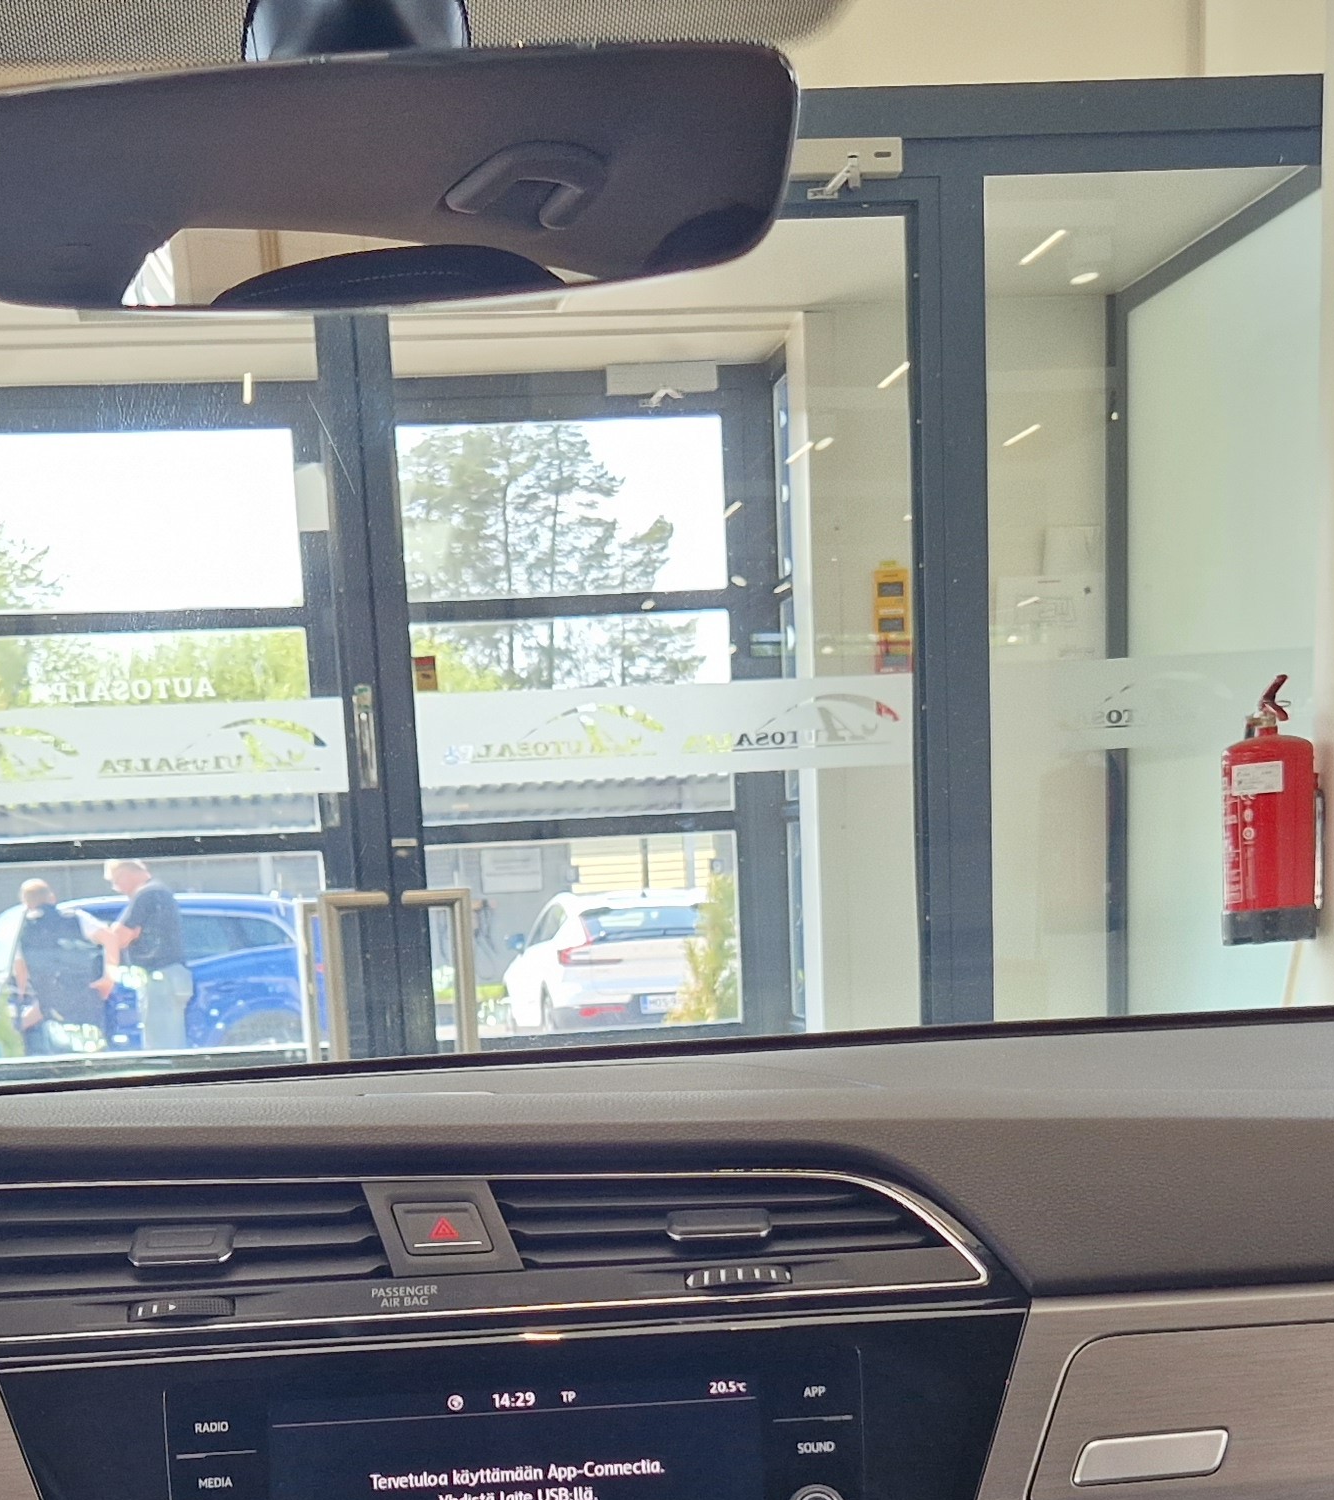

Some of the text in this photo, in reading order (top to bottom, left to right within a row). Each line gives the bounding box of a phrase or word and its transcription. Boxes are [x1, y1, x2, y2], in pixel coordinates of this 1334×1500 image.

[371, 1284, 438, 1298] PASSENGER
[380, 1296, 429, 1308] AIR BAG
[803, 1385, 827, 1399] APP
[492, 1391, 536, 1409] 14:29
[561, 1390, 577, 1403] TP
[194, 1421, 229, 1434] RADIO
[797, 1440, 836, 1455] SOUND
[369, 1457, 666, 1491] Tervetuloa käyttämään App-Connectia.
[198, 1476, 233, 1489] MEDIA
